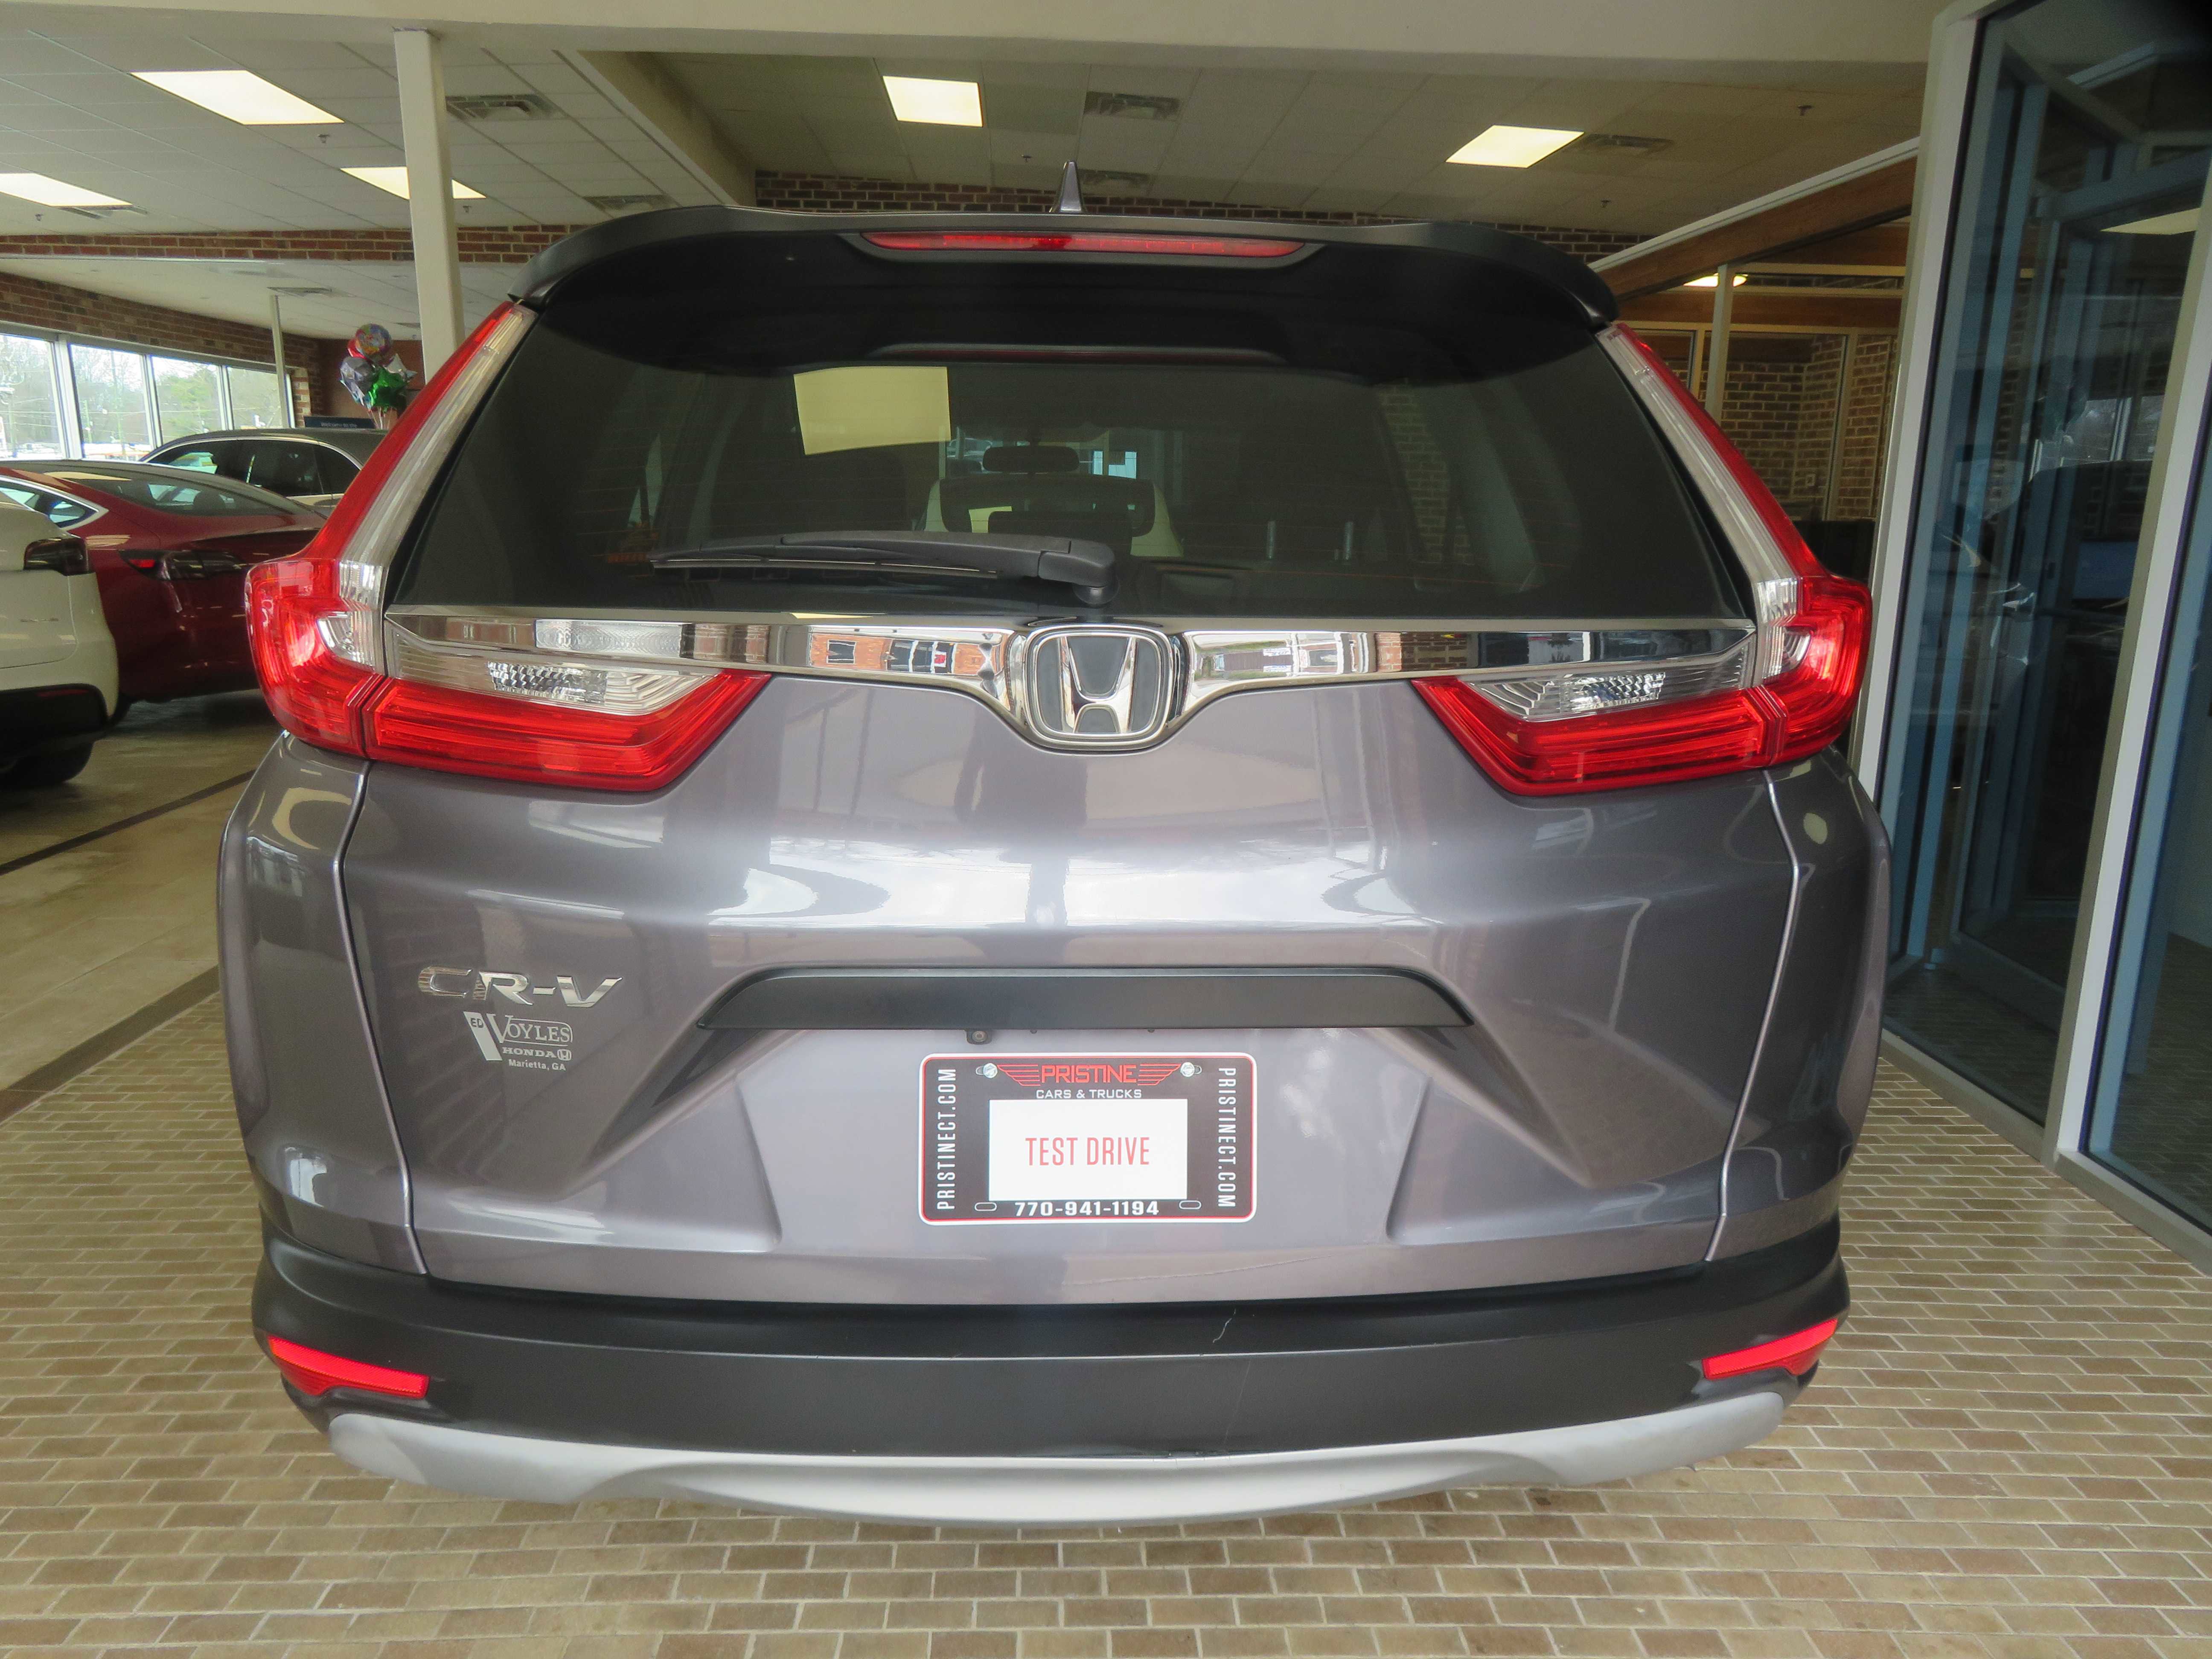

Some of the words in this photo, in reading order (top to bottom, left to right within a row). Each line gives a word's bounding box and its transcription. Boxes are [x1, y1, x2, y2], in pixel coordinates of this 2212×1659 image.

[418, 966, 623, 1008] CR-V
[470, 1018, 484, 1028] ED
[502, 1047, 556, 1059] HONDA
[509, 1059, 549, 1071] Marietta,
[552, 1062, 566, 1071] GA
[1041, 1065, 1137, 1083] PRISTINE
[1036, 1090, 1071, 1099] CARS
[1076, 1090, 1085, 1099] &
[1089, 1089, 1142, 1099] TRUCKS
[937, 1068, 957, 1211] PRISTINECT.COM
[1217, 1068, 1237, 1208] PRISTINECT.COM
[1025, 1137, 1078, 1166] TEST
[1087, 1137, 1150, 1165] DRIVE
[1015, 1201, 1159, 1217] 770-941-1194
